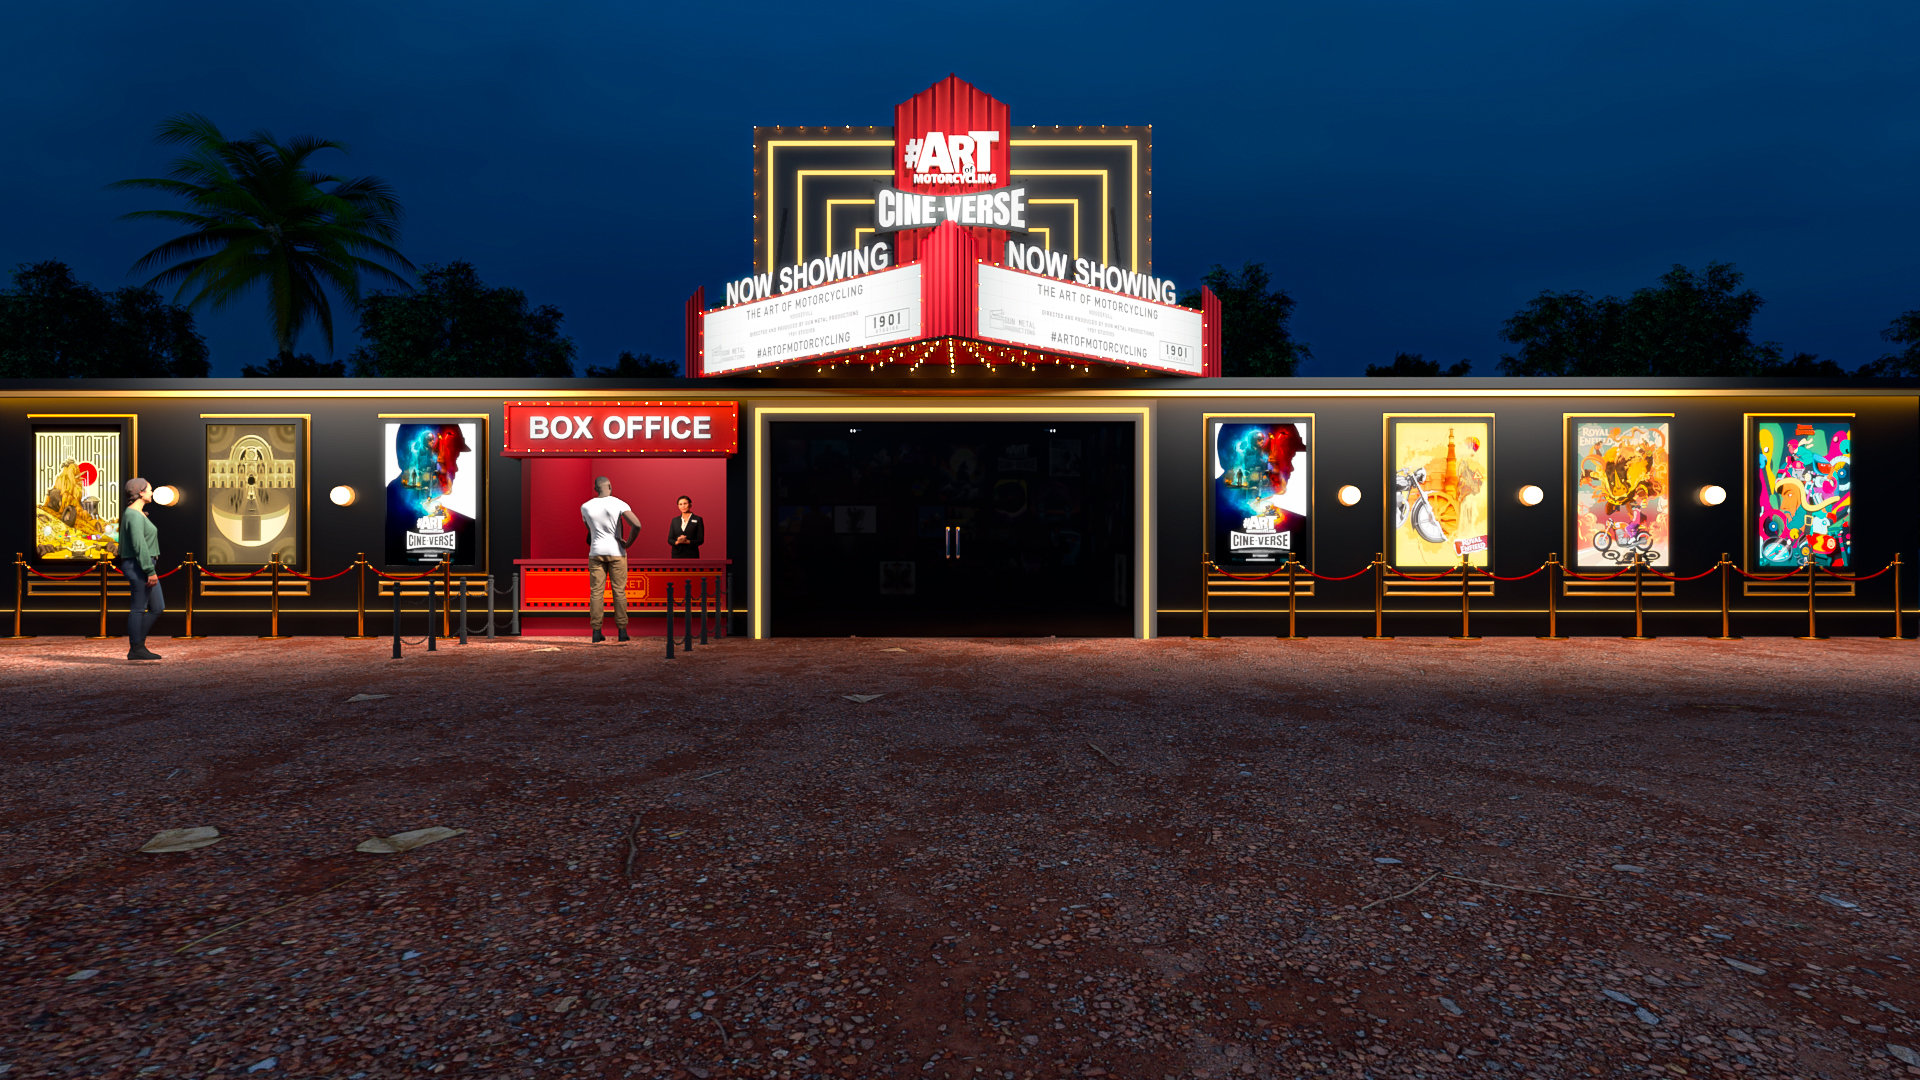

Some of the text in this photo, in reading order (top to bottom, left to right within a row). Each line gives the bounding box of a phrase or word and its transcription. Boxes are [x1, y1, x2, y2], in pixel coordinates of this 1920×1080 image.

[904, 131, 999, 173] #ART
[964, 166, 974, 174] of
[913, 174, 997, 184] MOTORCYCLING
[878, 188, 1026, 228] CINE-VERSE
[726, 242, 888, 306] NOW SHOWING
[1008, 240, 1176, 305] NOW SHOWING
[747, 284, 863, 320] THE ART OF MOTORCYCLING
[1038, 284, 1158, 320] THE ART OF MOTORCYCLING
[873, 312, 901, 329] 1901
[1018, 320, 1036, 329] METAL
[876, 324, 898, 334] STUDIOS
[757, 332, 850, 358] #ARTOFMOTORCYCLING
[1051, 332, 1148, 358] #ARTOFMOTORCYCLING
[1166, 344, 1188, 358] 1901
[530, 416, 712, 440] BOX OFFICE
[1582, 428, 1609, 436] ROYAL
[416, 516, 445, 530] #ART
[1243, 516, 1277, 530] #ART
[408, 534, 454, 546] CINE-VERSE
[1233, 534, 1288, 546] CINE-VERSE
[1462, 536, 1482, 546] ROYAL
[1461, 543, 1486, 552] ENFIELD
[606, 580, 642, 588] TKET
